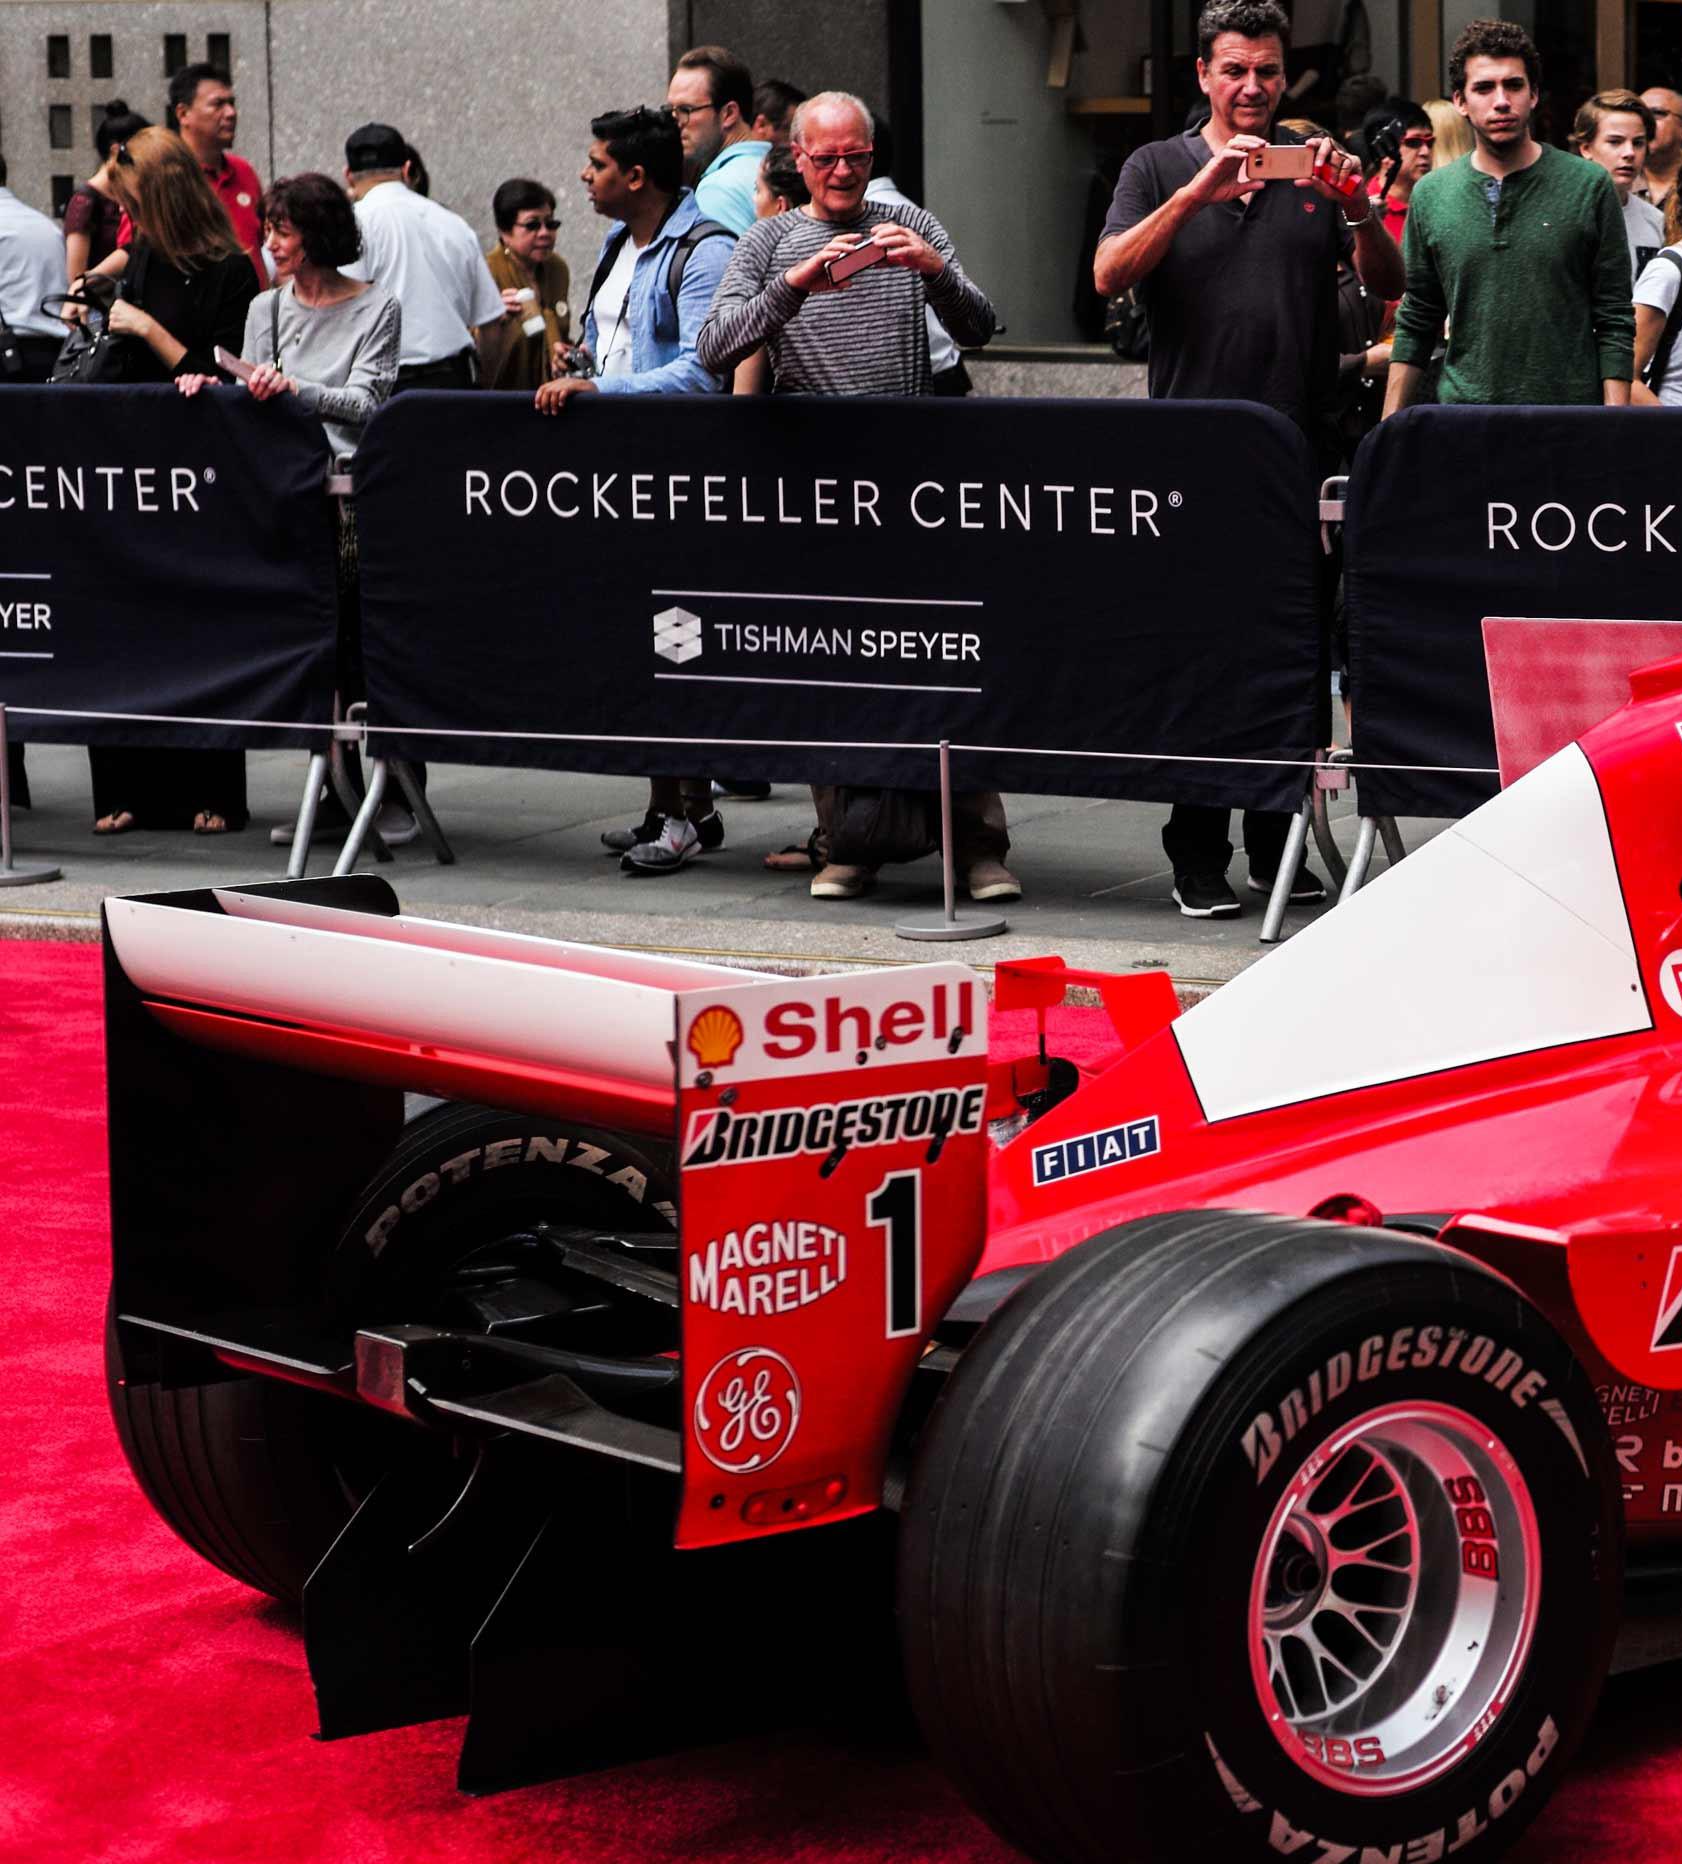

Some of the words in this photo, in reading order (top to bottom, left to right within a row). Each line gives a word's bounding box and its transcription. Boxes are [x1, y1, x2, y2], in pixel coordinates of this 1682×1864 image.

[465, 469, 882, 526] ROCKEFELLER
[0, 602, 52, 630] YER
[713, 623, 852, 656] TISHMAN
[859, 629, 981, 662] SPEYER
[762, 981, 974, 1060] Shell
[682, 1083, 988, 1171] BRIDGESTONE
[1039, 1121, 1154, 1181] FIAT
[364, 1136, 648, 1260] POTENZA
[689, 1220, 847, 1284] MAGNETI
[866, 1168, 922, 1339] 1
[689, 1255, 847, 1317] MARELLI
[1240, 1325, 1548, 1487] BRIDGESTONE
[1594, 1384, 1660, 1409] GNETI
[1442, 1474, 1499, 1581] BBS
[1298, 1729, 1387, 1769] BBS
